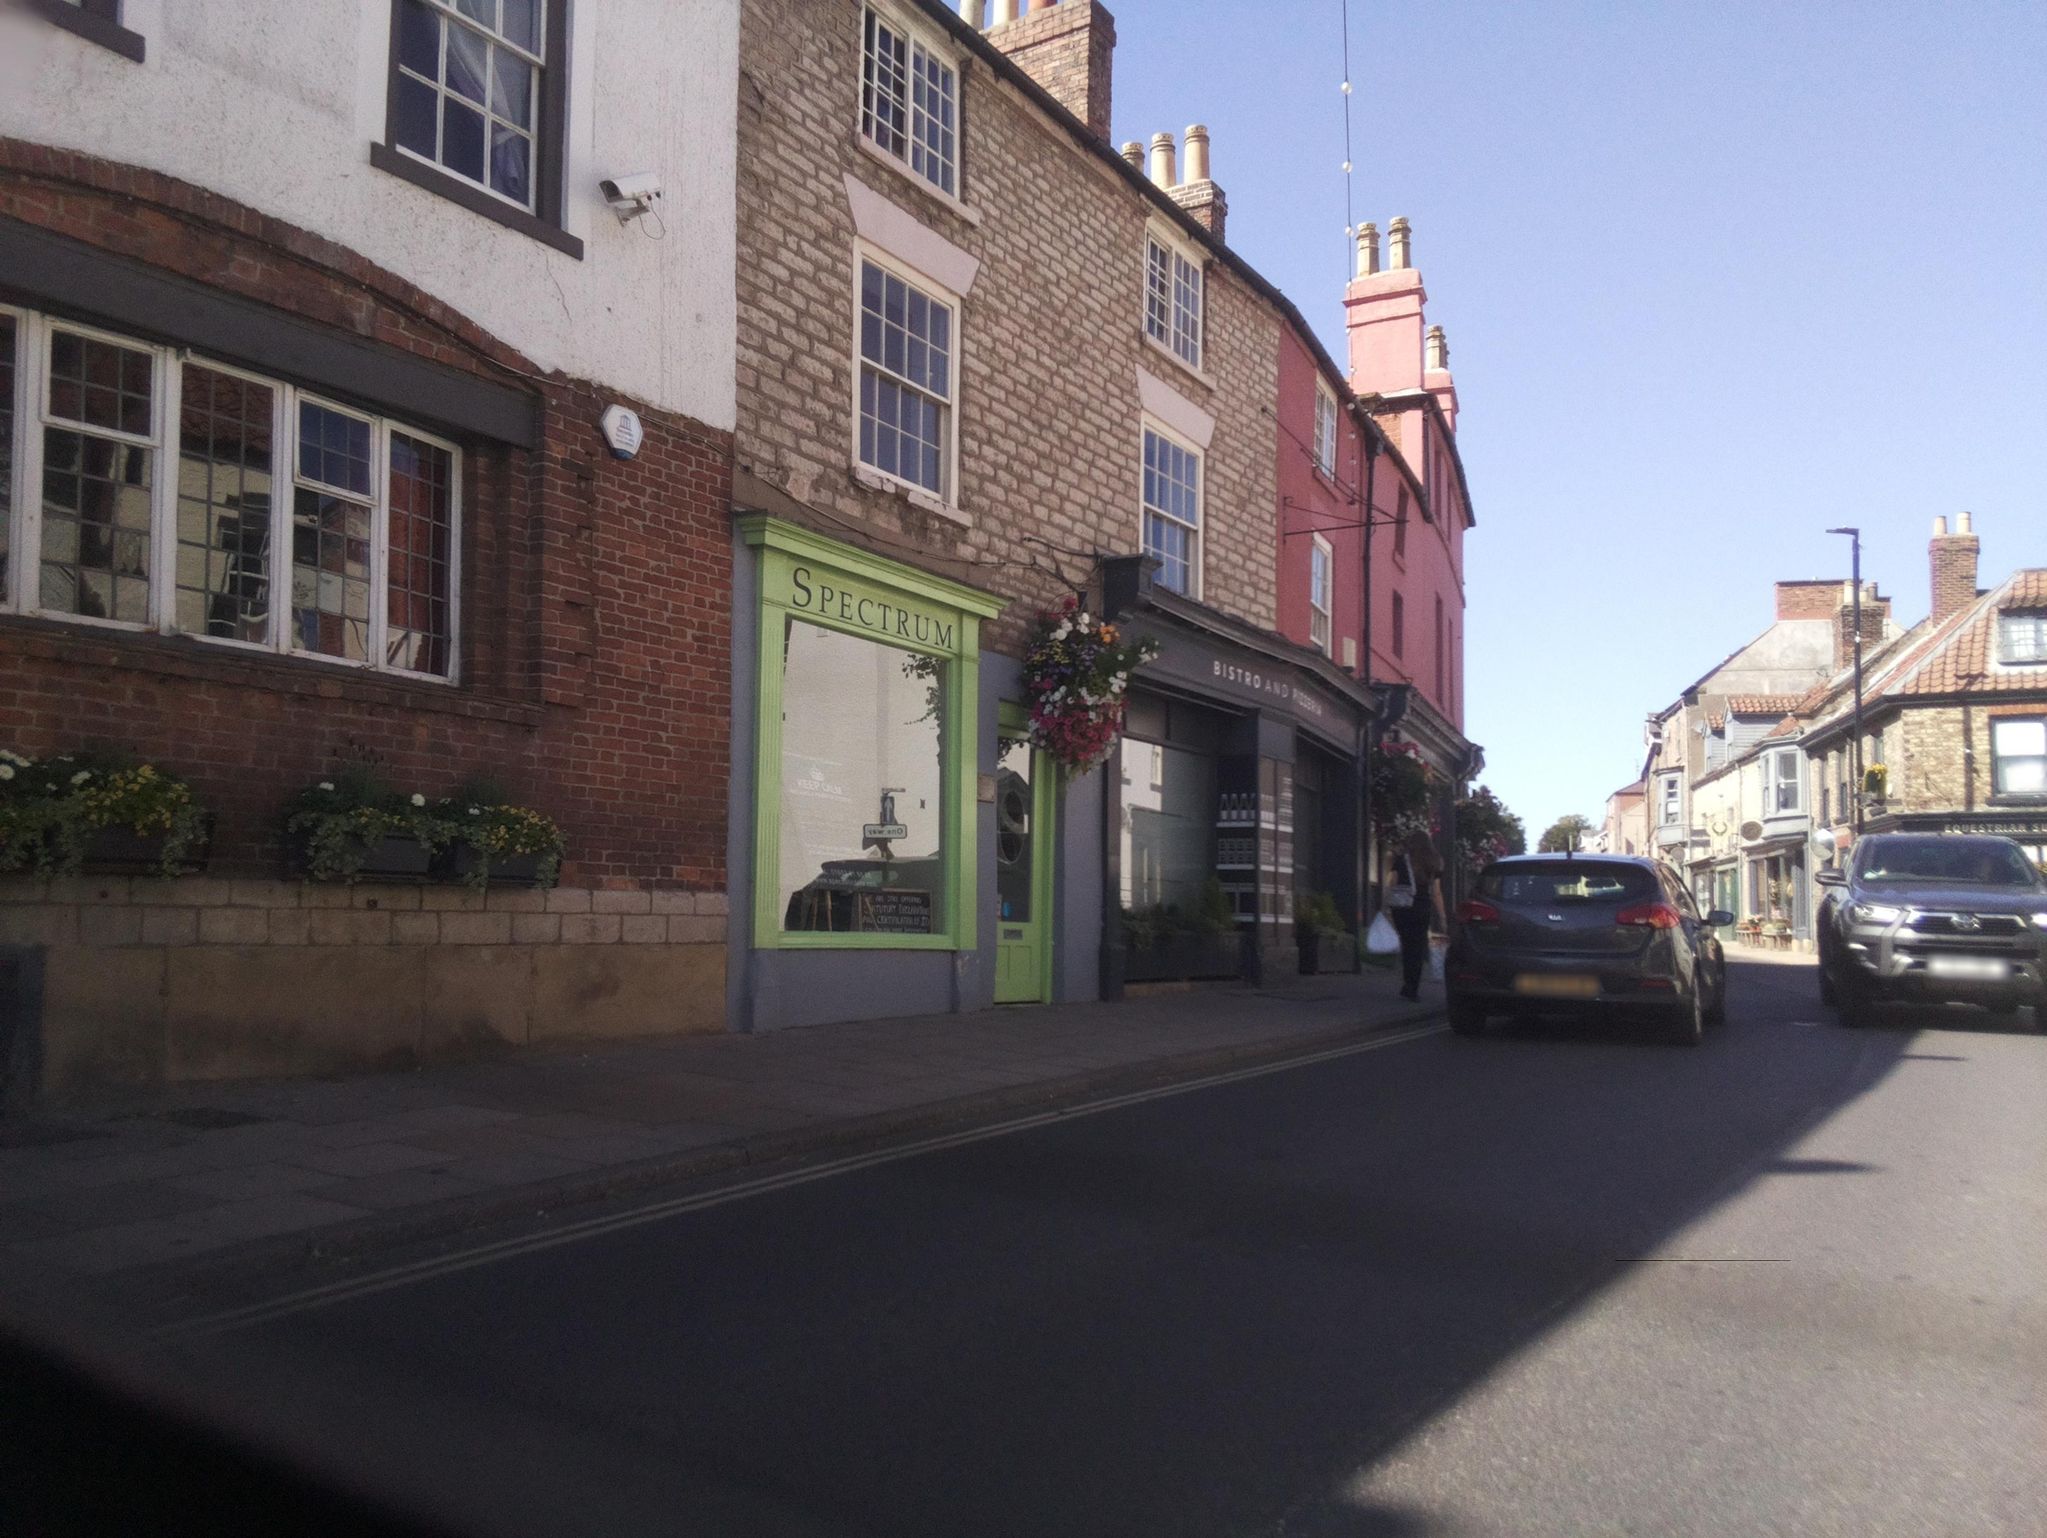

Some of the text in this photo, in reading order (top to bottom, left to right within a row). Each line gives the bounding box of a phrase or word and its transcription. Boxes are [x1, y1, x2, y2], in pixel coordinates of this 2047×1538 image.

[793, 567, 953, 649] SPECTRUM
[1213, 660, 1261, 688] BISTRO
[1263, 679, 1289, 698] AND
[1944, 823, 2027, 835] EQUESTRIAN
